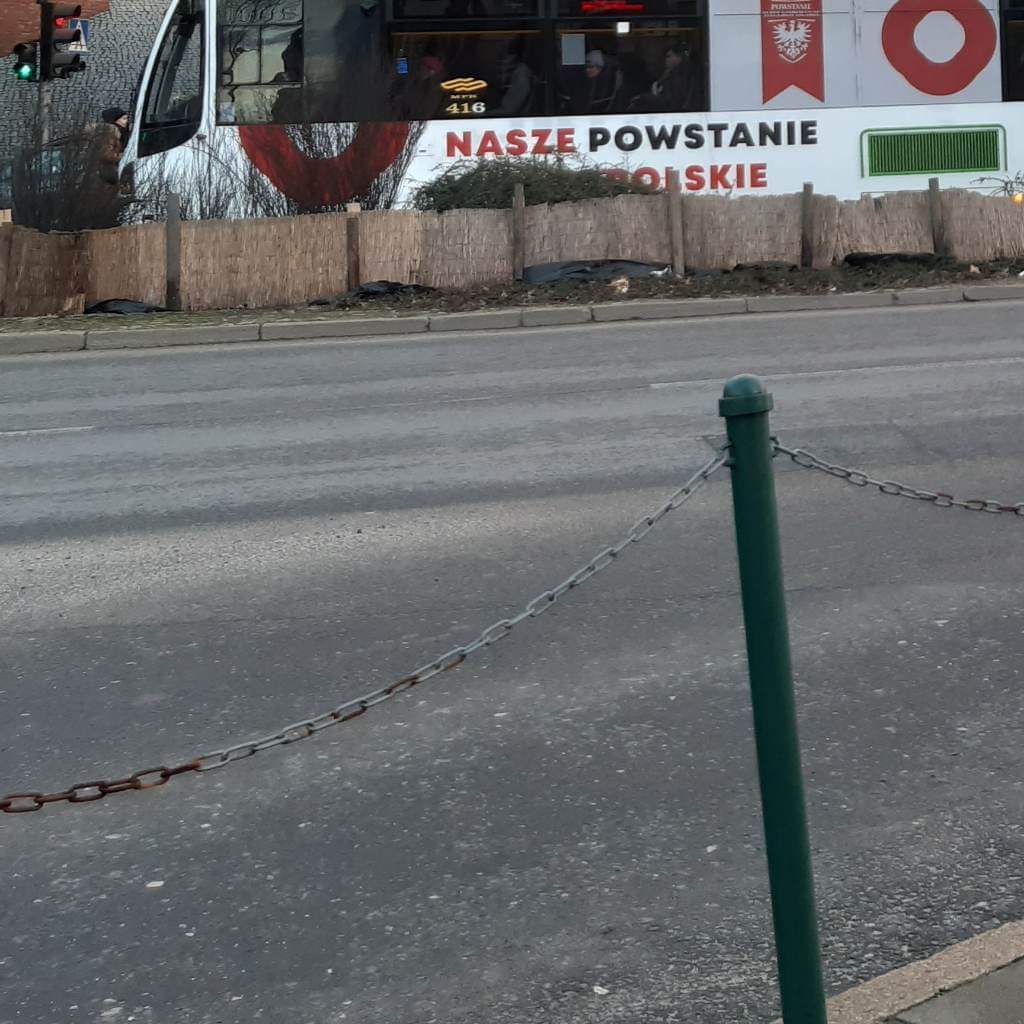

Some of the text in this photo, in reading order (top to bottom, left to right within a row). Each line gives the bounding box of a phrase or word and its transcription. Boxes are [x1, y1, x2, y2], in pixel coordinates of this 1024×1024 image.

[445, 101, 486, 114] 416
[446, 120, 818, 157] NASZE POWSTANIE
